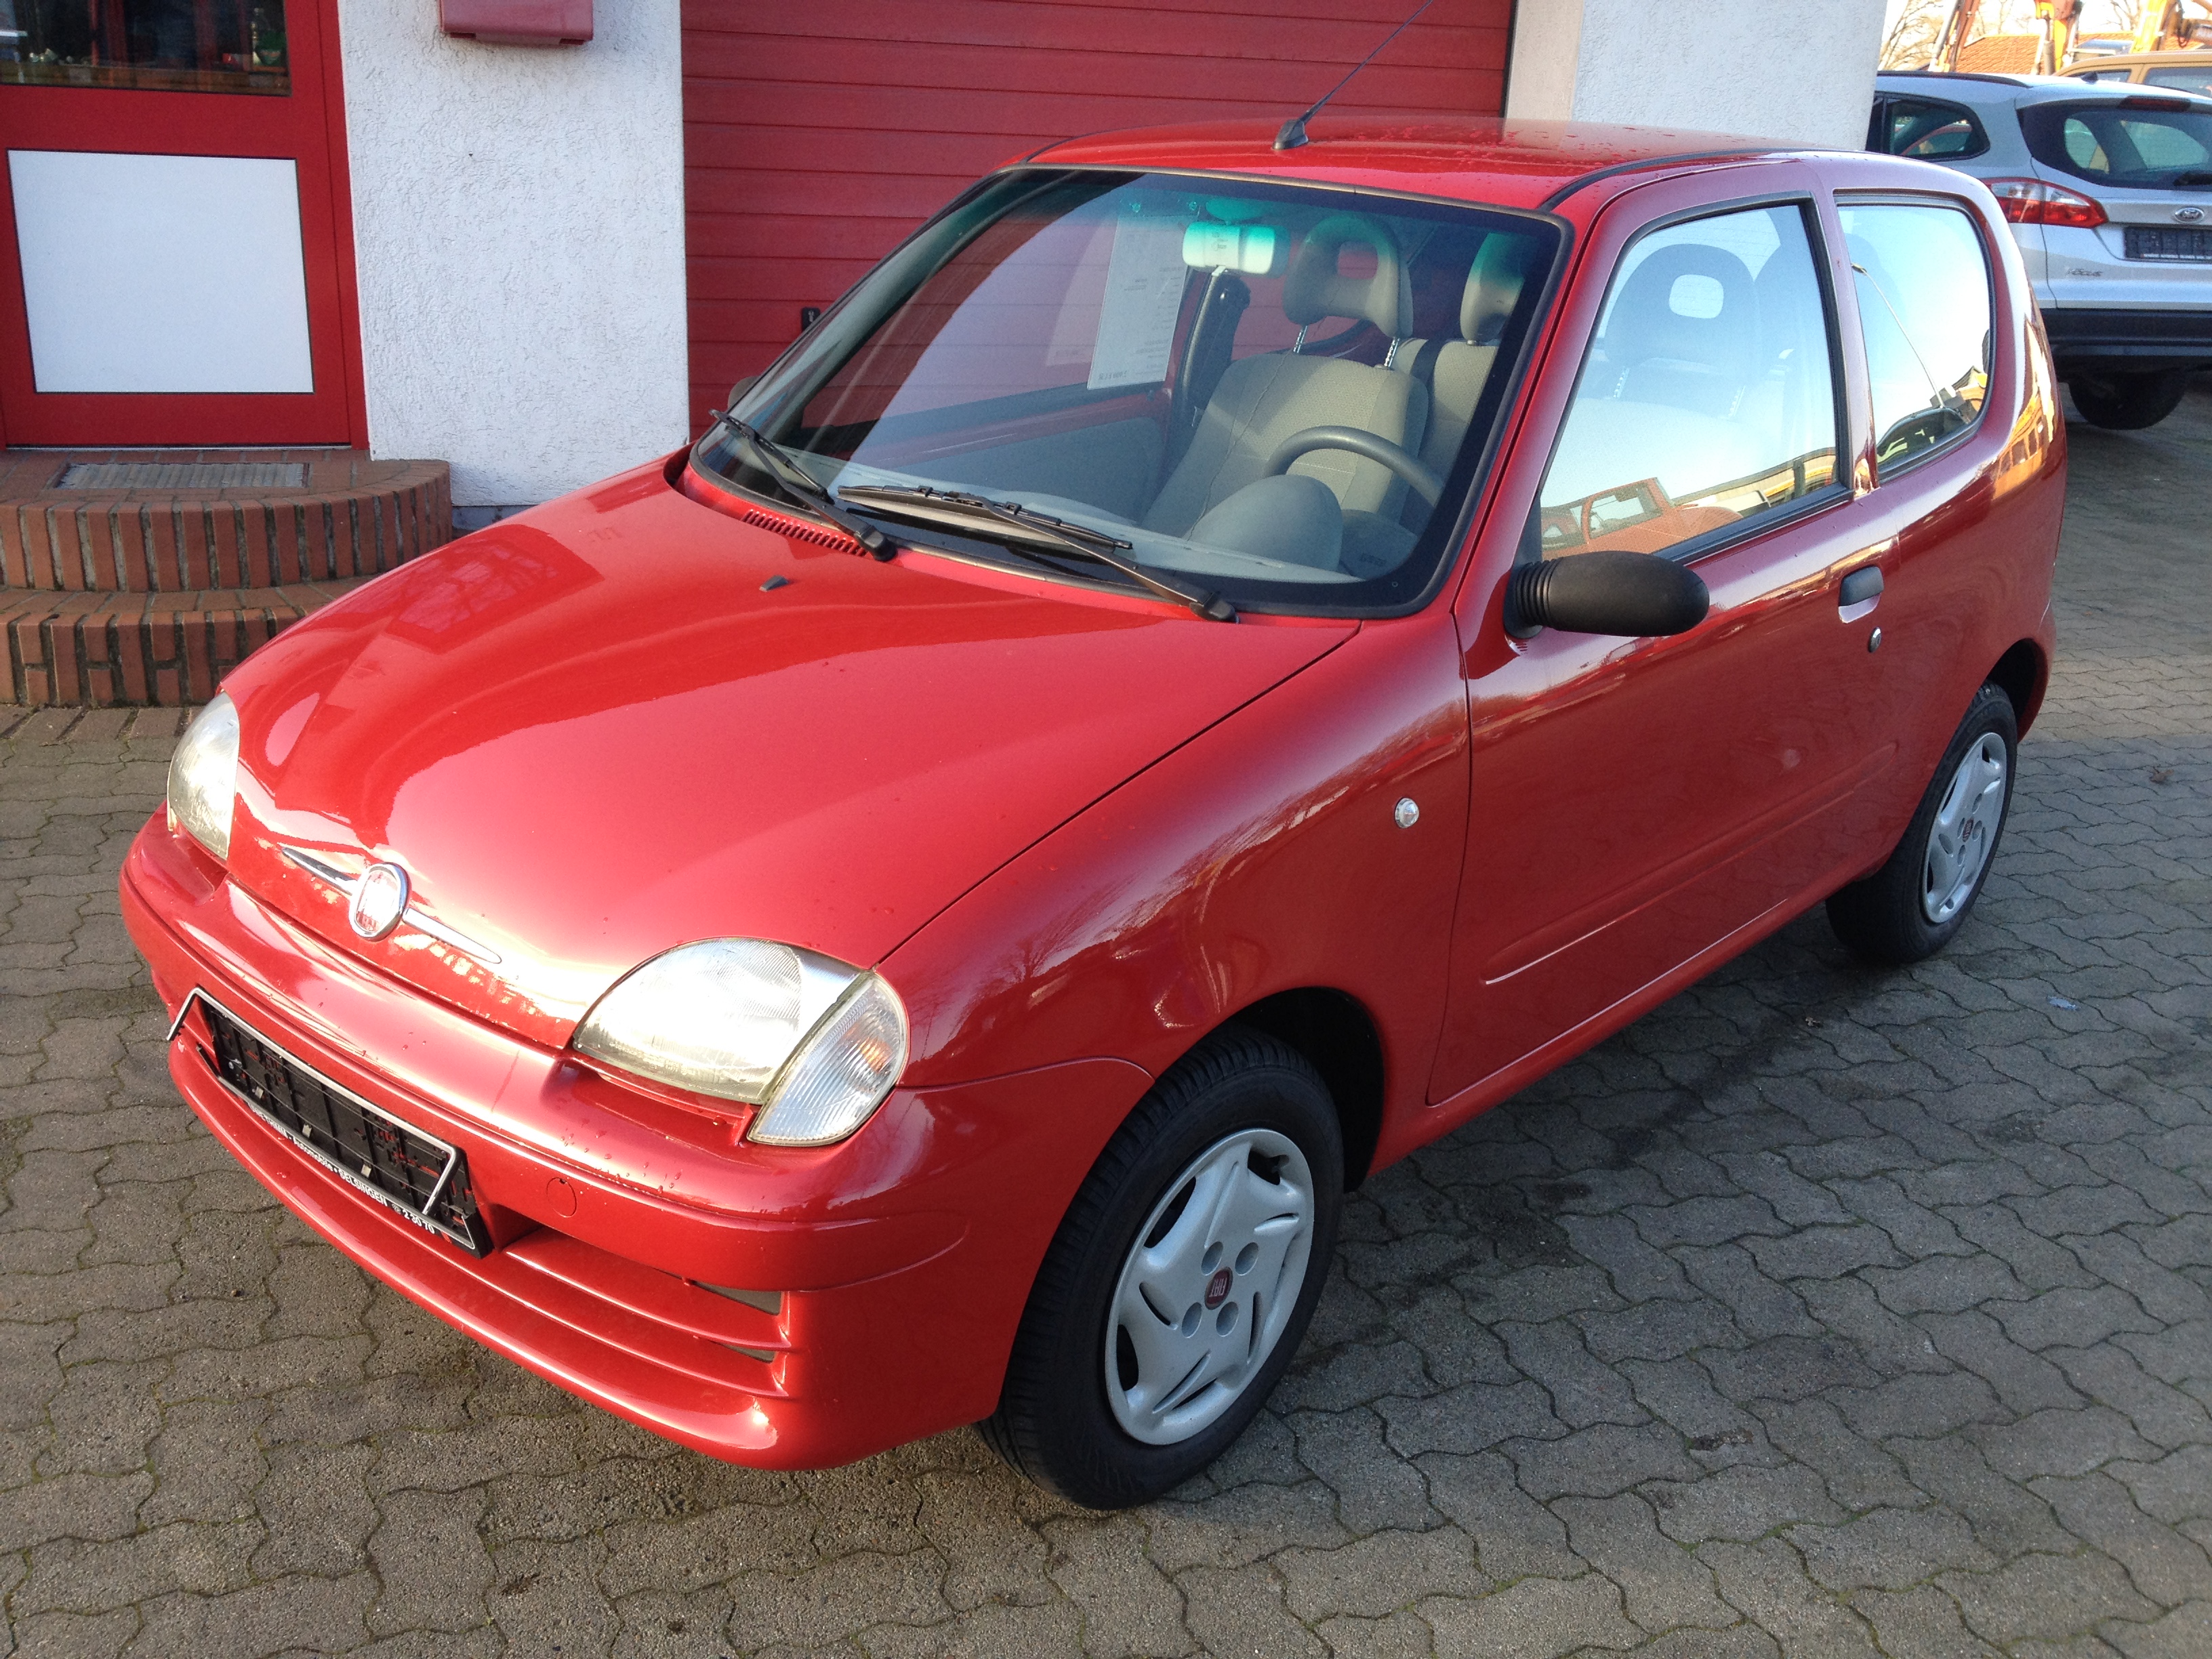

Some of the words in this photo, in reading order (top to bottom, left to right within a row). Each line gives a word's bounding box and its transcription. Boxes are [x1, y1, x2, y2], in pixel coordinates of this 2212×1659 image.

[339, 1168, 388, 1207] SELSINGEN
[403, 1209, 410, 1220] 2
[422, 1221, 435, 1235] 70
[1208, 1277, 1227, 1298] FIAT
